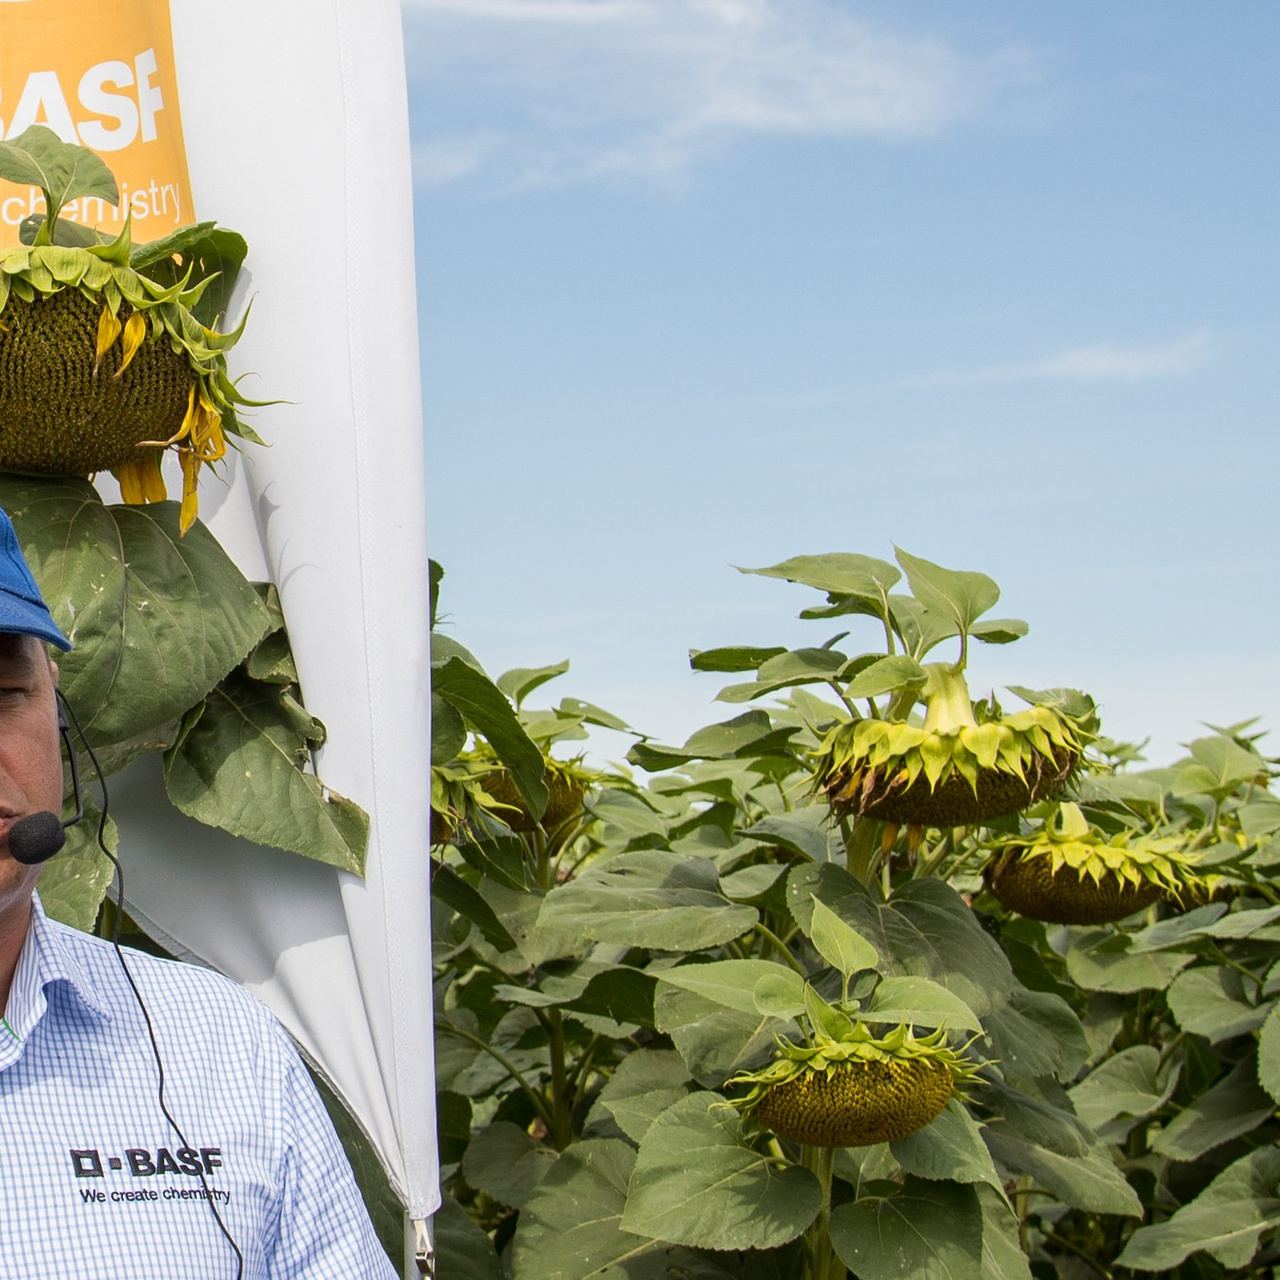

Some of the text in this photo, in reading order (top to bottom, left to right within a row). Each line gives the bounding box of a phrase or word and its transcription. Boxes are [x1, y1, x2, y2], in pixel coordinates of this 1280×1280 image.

[125, 1147, 223, 1177] BASF
[79, 1189, 106, 1203] We
[110, 1188, 158, 1202] create
